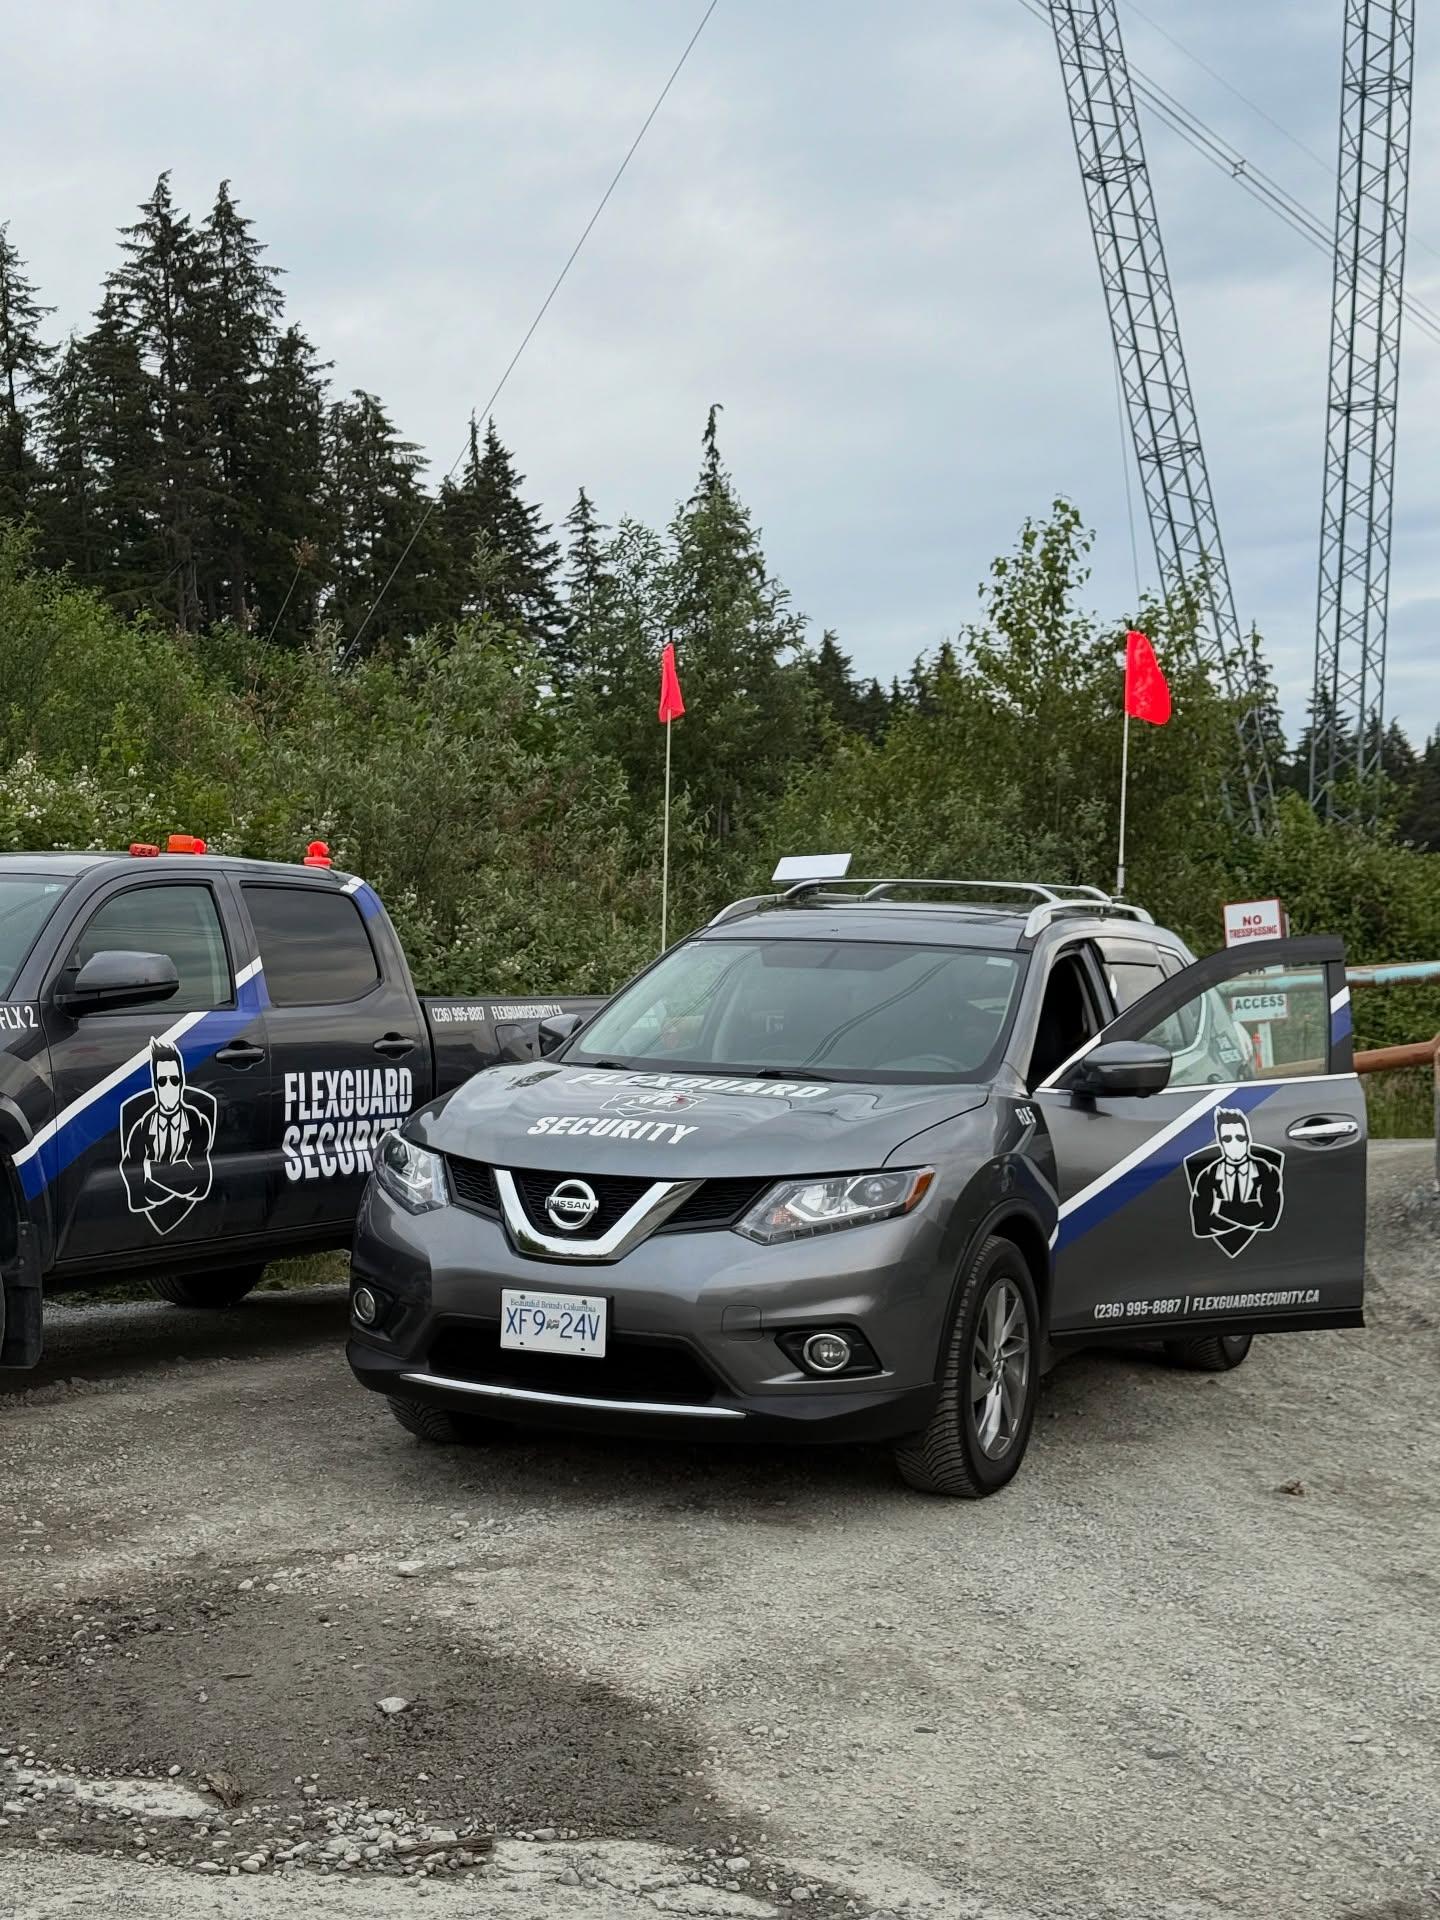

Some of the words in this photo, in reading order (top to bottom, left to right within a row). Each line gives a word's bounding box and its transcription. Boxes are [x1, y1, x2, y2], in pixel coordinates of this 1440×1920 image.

[1243, 914, 1262, 926] NO
[1235, 995, 1285, 1010] ACCESS
[0, 1006, 27, 1030] FLX
[24, 1005, 39, 1028] 2
[431, 1006, 453, 1023] (236)
[451, 1006, 486, 1022] 995-8887
[284, 1067, 413, 1122] FLEXGUARD
[566, 1073, 831, 1099] FLEXGUARD
[527, 1115, 700, 1145] SECURITY
[548, 1199, 591, 1211] NISSAN
[510, 1298, 540, 1308] Beautiful
[541, 1300, 563, 1310] British
[563, 1302, 596, 1313] Columbia
[1093, 1302, 1125, 1319] (236)
[1126, 1299, 1181, 1316] 995-8887
[1192, 1289, 1320, 1311] FLEXGUARDSECURITY.CA
